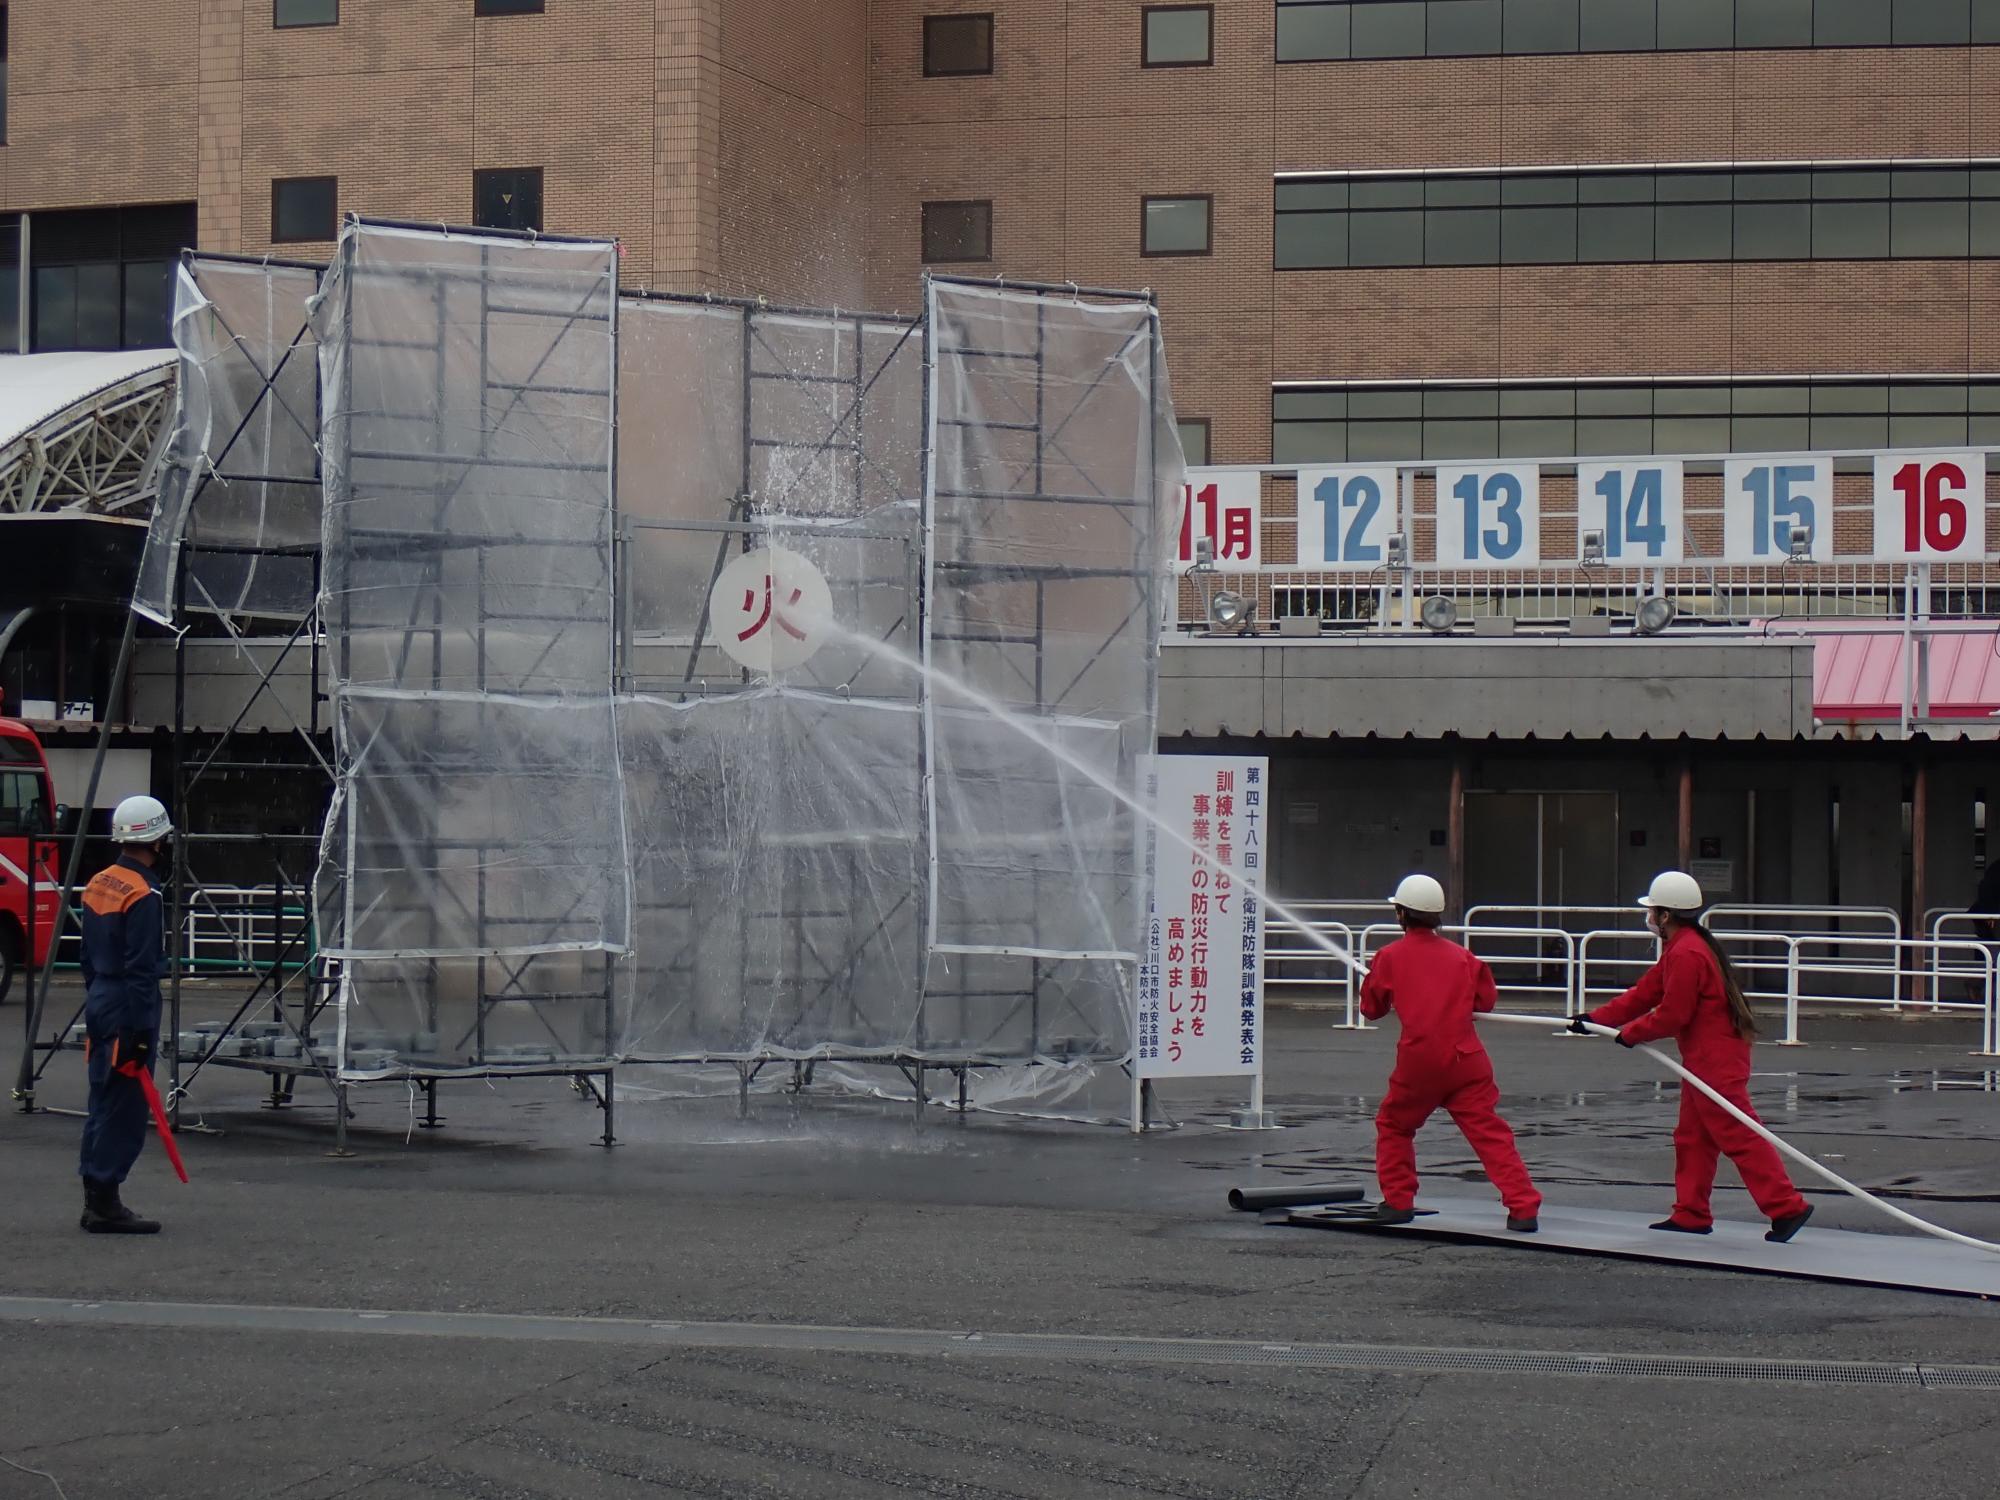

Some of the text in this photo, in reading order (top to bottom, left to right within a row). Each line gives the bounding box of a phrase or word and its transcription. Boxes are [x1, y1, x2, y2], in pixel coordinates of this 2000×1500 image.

[1315, 476, 1382, 562] 12
[1454, 473, 1523, 560] 13
[1595, 469, 1667, 558] 14
[1743, 466, 1816, 556] 15
[1892, 462, 1967, 553] 16
[737, 574, 808, 643] 火
[1215, 770, 1234, 914] 訓練を重ねて
[1167, 917, 1185, 1062] 高めましょう
